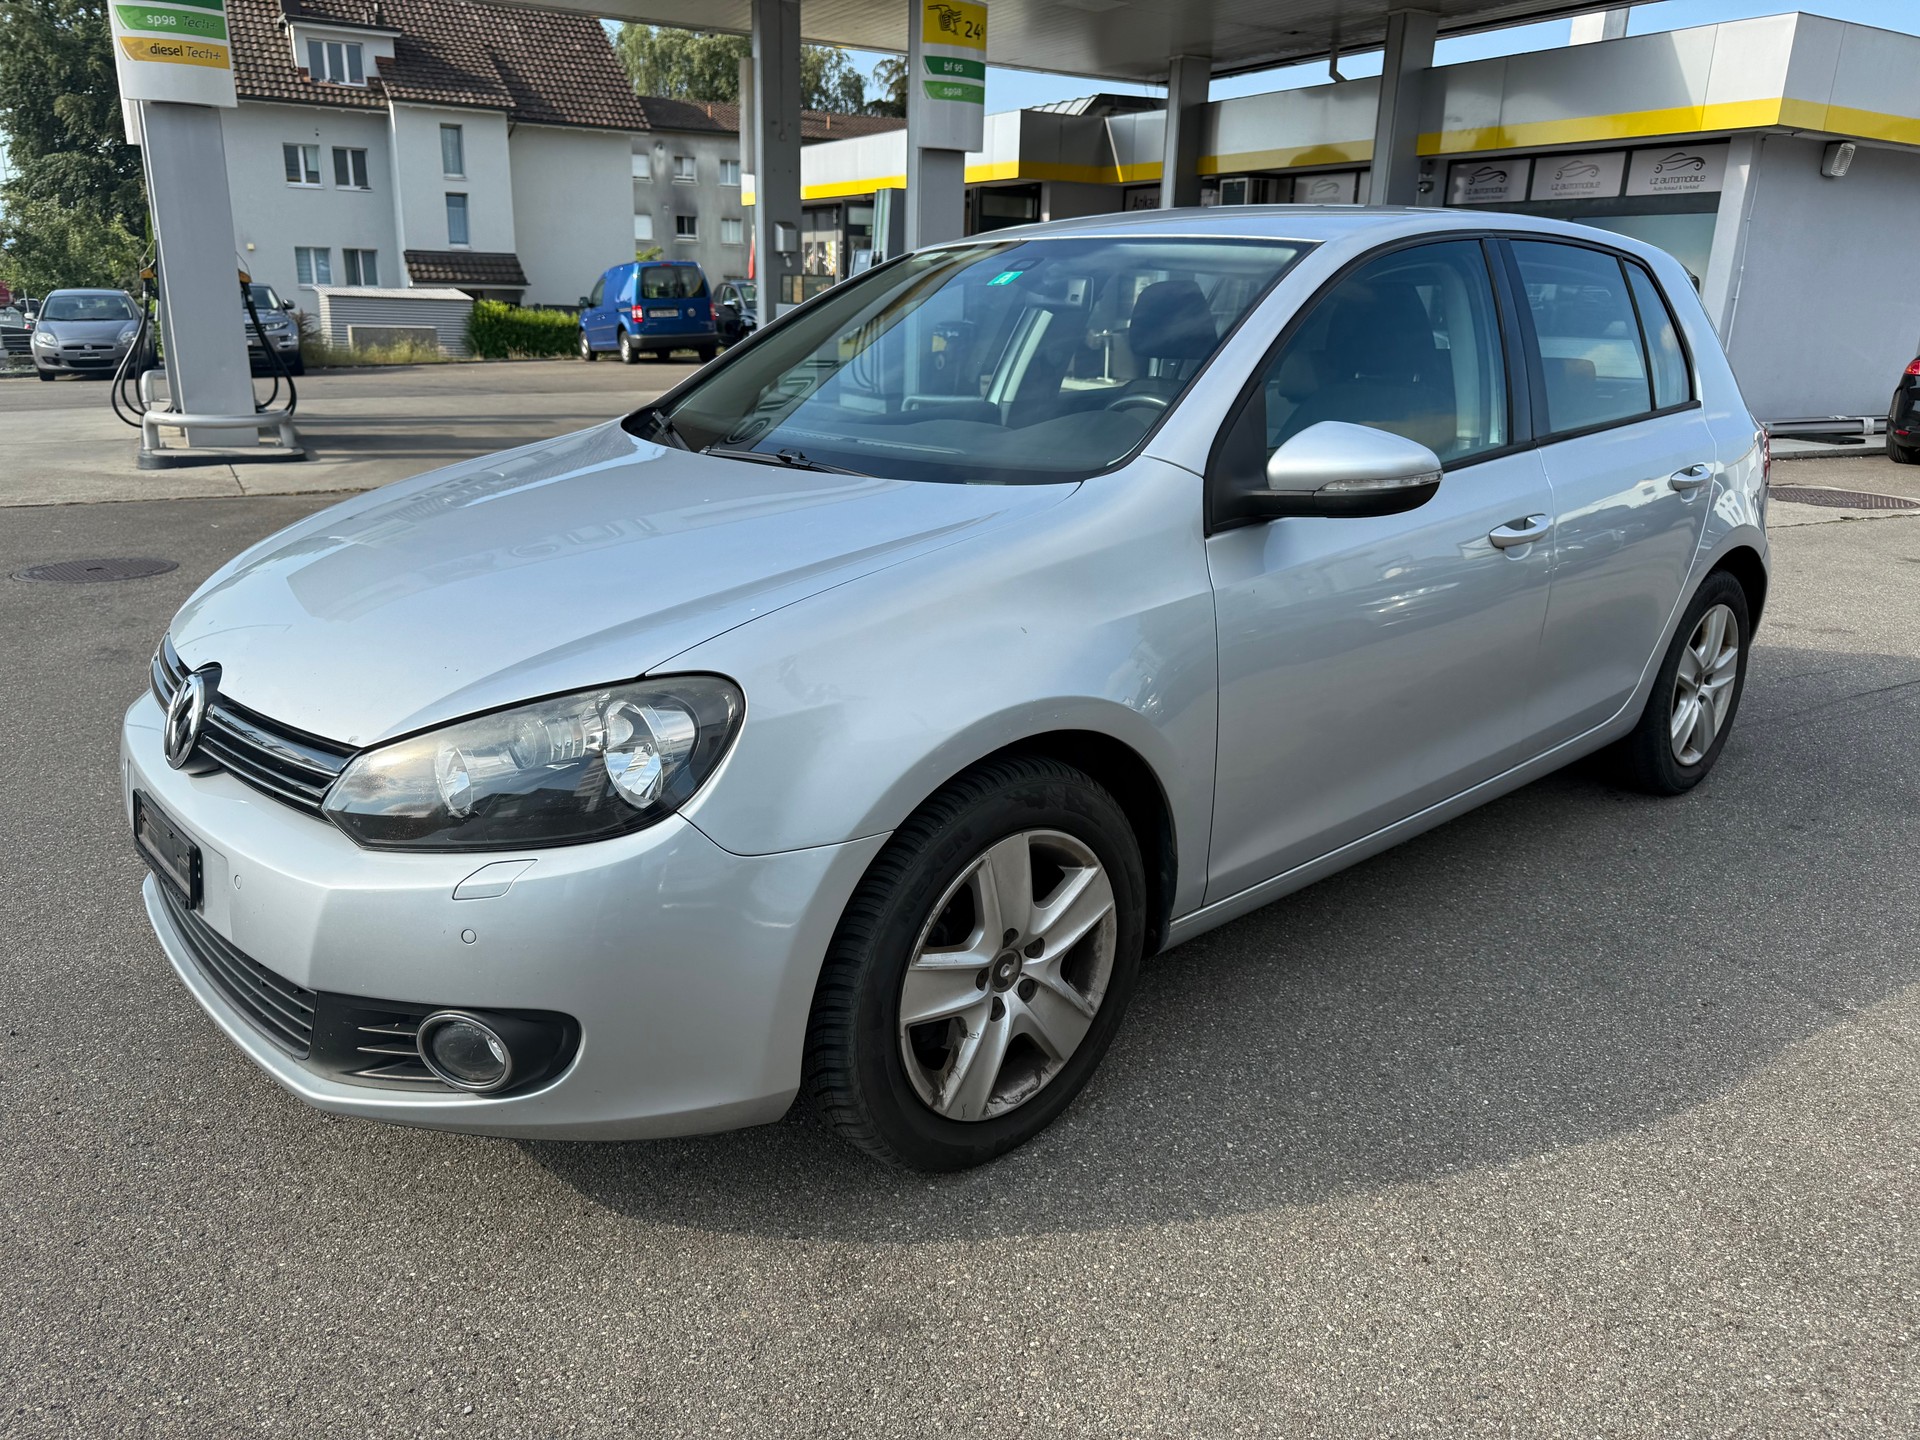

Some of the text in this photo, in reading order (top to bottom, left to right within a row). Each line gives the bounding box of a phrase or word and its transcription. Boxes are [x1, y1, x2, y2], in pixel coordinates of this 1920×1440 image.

[146, 14, 218, 30] sp98 Tech+
[150, 43, 222, 60] diesel Tech+
